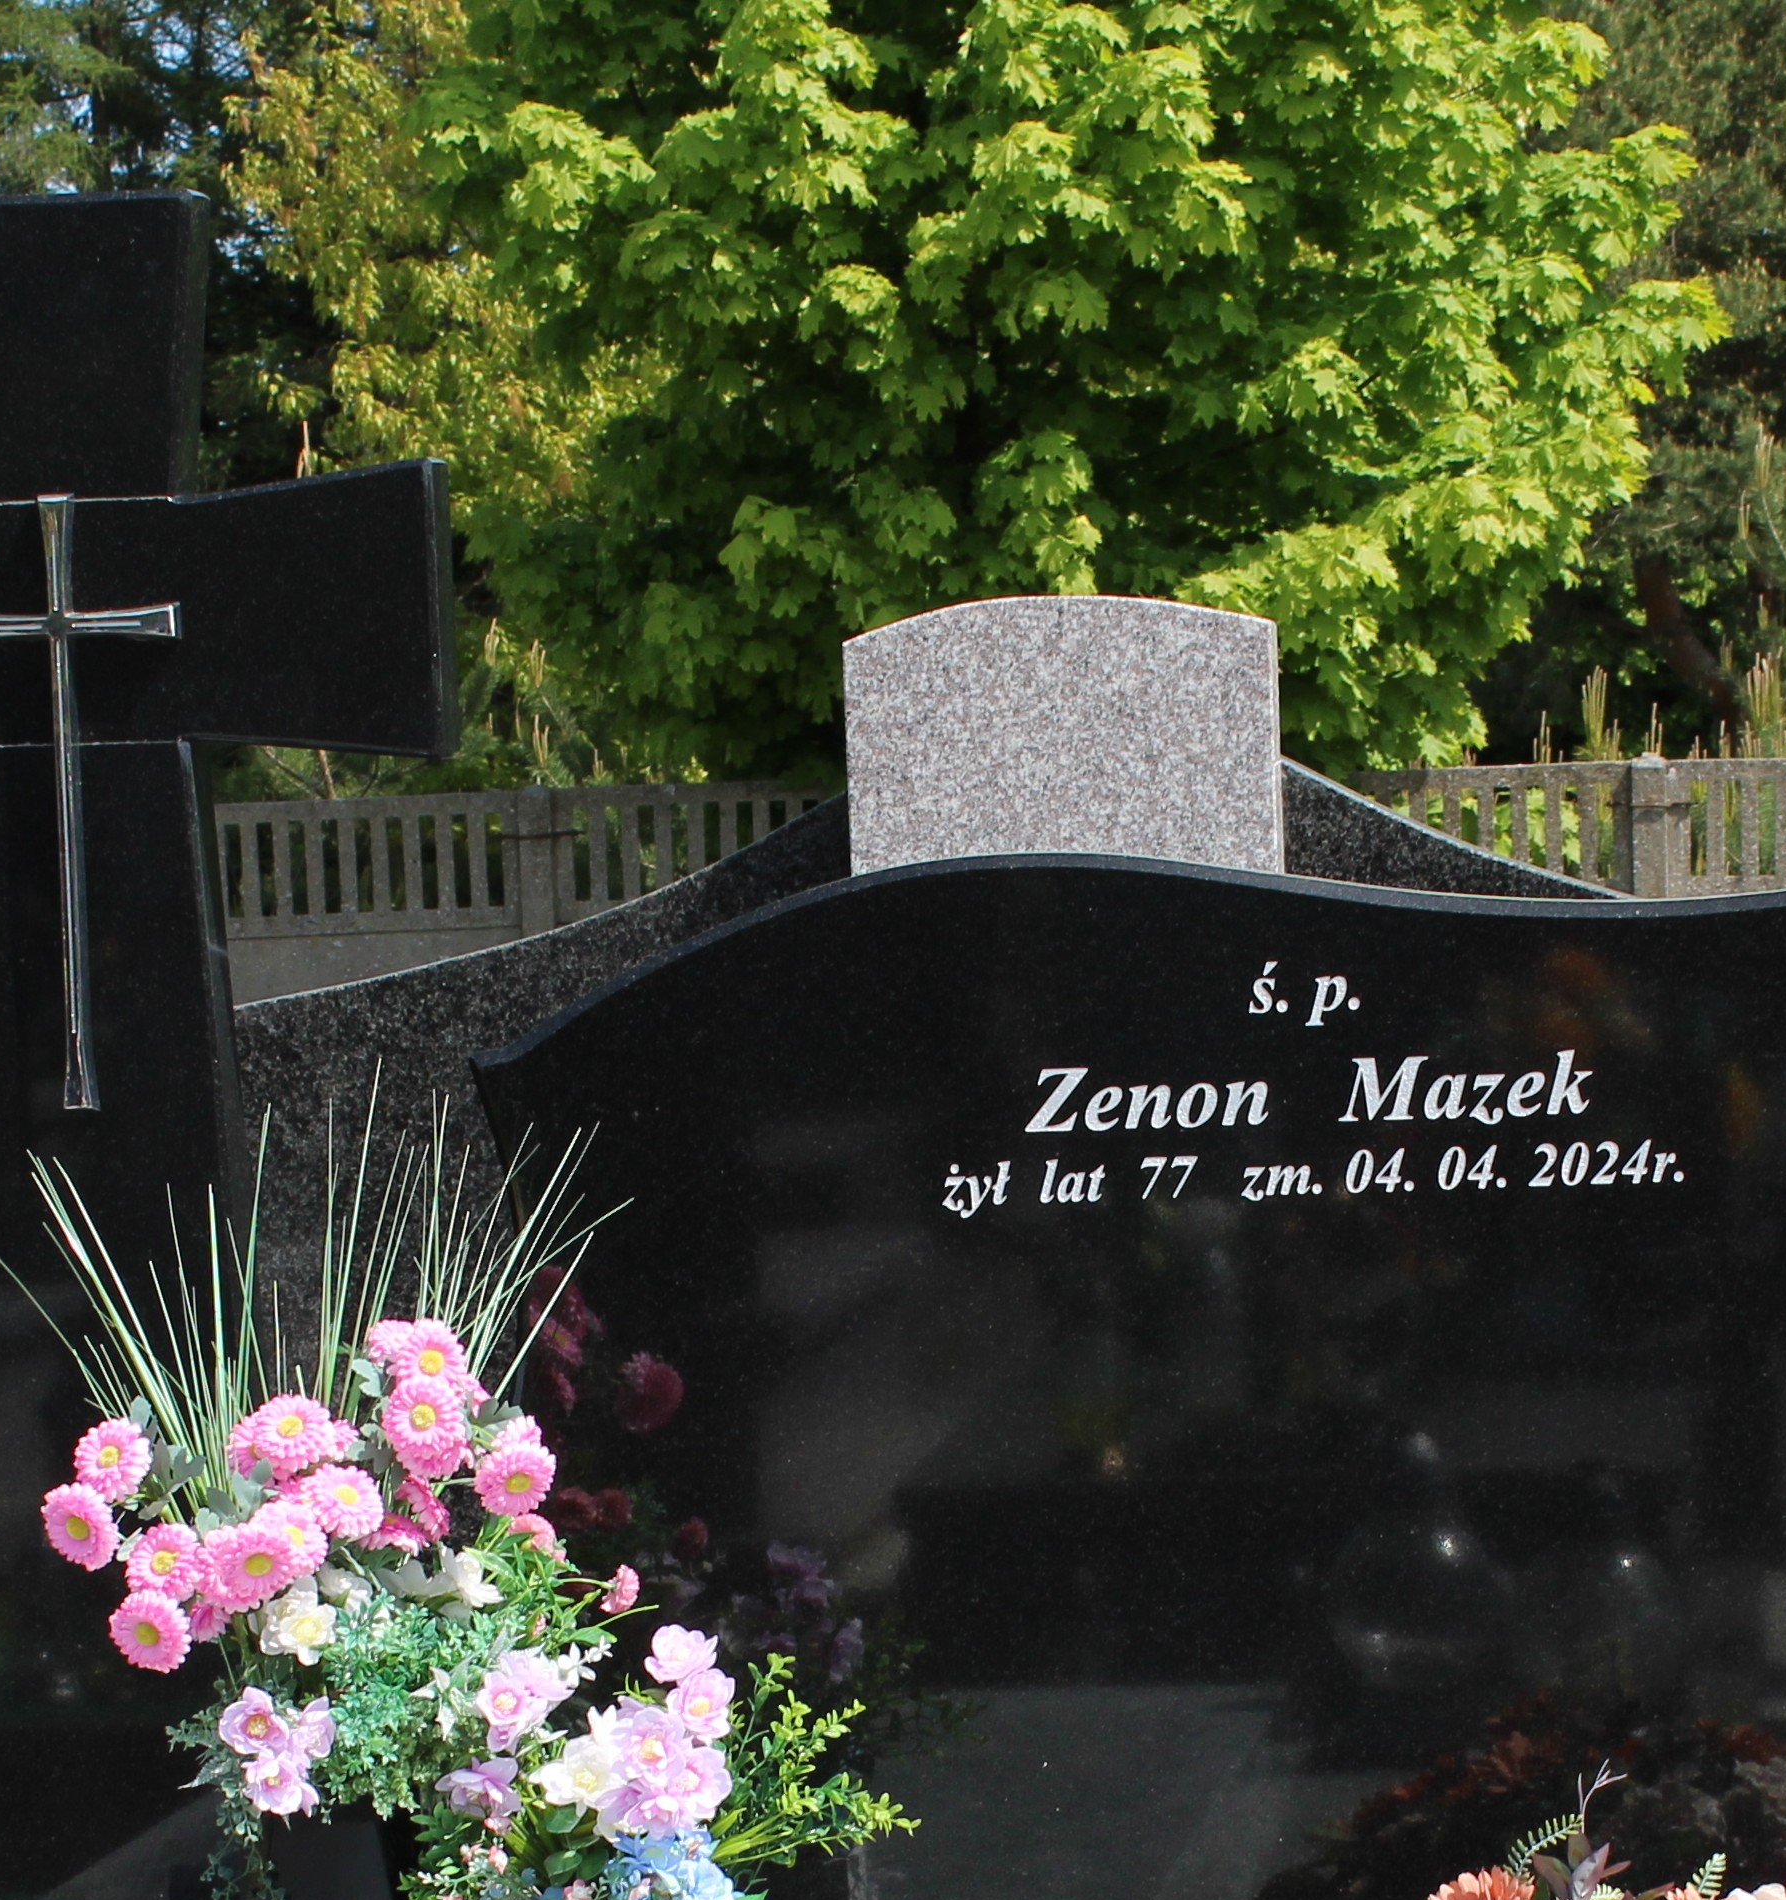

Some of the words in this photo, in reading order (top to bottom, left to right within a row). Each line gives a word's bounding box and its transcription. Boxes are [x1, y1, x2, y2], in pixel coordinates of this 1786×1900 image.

[1249, 960, 1289, 1014] ś.
[1305, 976, 1361, 1027] p.
[1025, 1068, 1269, 1132] Zenon
[1338, 1050, 1593, 1126] Mazek
[941, 1158, 1011, 1219] żył
[1039, 1157, 1106, 1204] lat
[1140, 1155, 1199, 1199] 77
[1241, 1165, 1323, 1202] zm.
[1345, 1145, 1416, 1193] 04.
[1437, 1142, 1508, 1191] 04.
[1528, 1138, 1685, 1188] 2024r.
